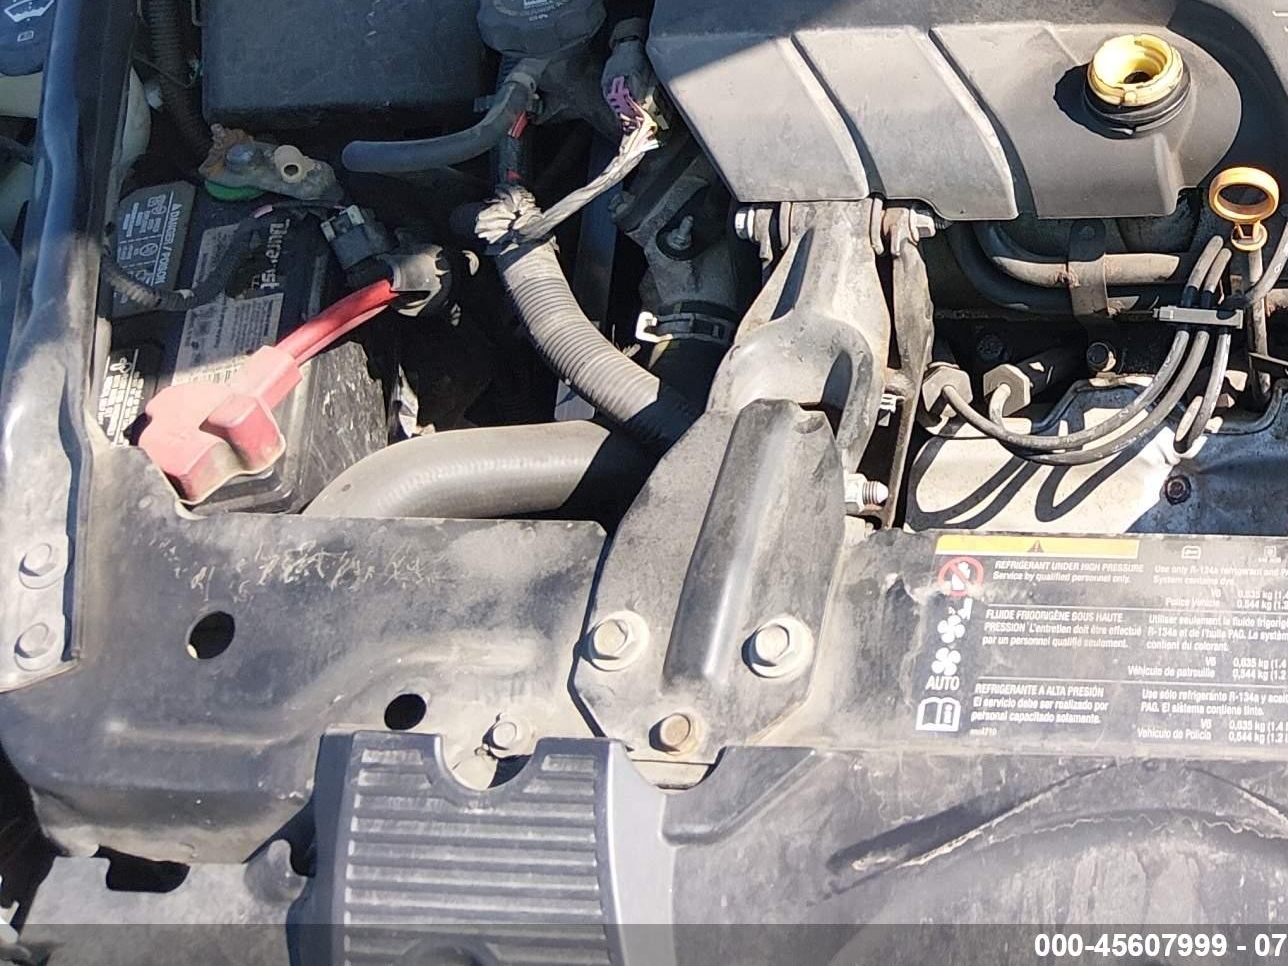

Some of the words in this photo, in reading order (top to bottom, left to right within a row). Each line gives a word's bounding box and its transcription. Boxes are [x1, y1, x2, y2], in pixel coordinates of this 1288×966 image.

[995, 561, 1050, 571] REFRIGERANT
[1051, 561, 1080, 571] UNDER
[1154, 565, 1170, 573] Use
[993, 571, 1024, 580] Service
[1024, 572, 1035, 582] by
[1036, 572, 1071, 582] qualified
[986, 609, 1015, 620] FLUIDE
[1071, 612, 1095, 621] SOUS
[1096, 612, 1123, 623] HAUTE
[1149, 614, 1178, 625] Utiliser
[1029, 623, 1072, 634] L'entretien
[1073, 625, 1089, 634] doit
[982, 637, 997, 646] par
[997, 637, 1009, 645] un
[1010, 636, 1051, 647] personnel
[1182, 641, 1192, 650] du
[1205, 656, 1216, 666] V6
[1258, 658, 1268, 670] kg
[1164, 666, 1174, 676] de
[1257, 670, 1268, 681] kg
[925, 676, 960, 691] AUTO
[975, 683, 1037, 695] REFRIGERANTE
[1038, 685, 1046, 694] A
[1046, 685, 1067, 696] ALTA
[1067, 684, 1104, 697] PRESIÓN
[1142, 689, 1158, 700] Use
[1229, 690, 1259, 702] R-134a
[1260, 693, 1266, 705] y
[973, 697, 983, 707] El
[983, 698, 1016, 708] servicio
[1017, 698, 1038, 709] debe
[1039, 701, 1053, 709] ser
[1055, 700, 1093, 710] realizado
[1094, 702, 1110, 712] por
[970, 712, 1008, 722] personal
[1009, 711, 1055, 723] capacitado
[1056, 713, 1101, 724] solamente.
[1200, 718, 1212, 729] V6
[1254, 721, 1266, 732] kg
[1173, 729, 1183, 739] de
[1254, 732, 1265, 744] kg
